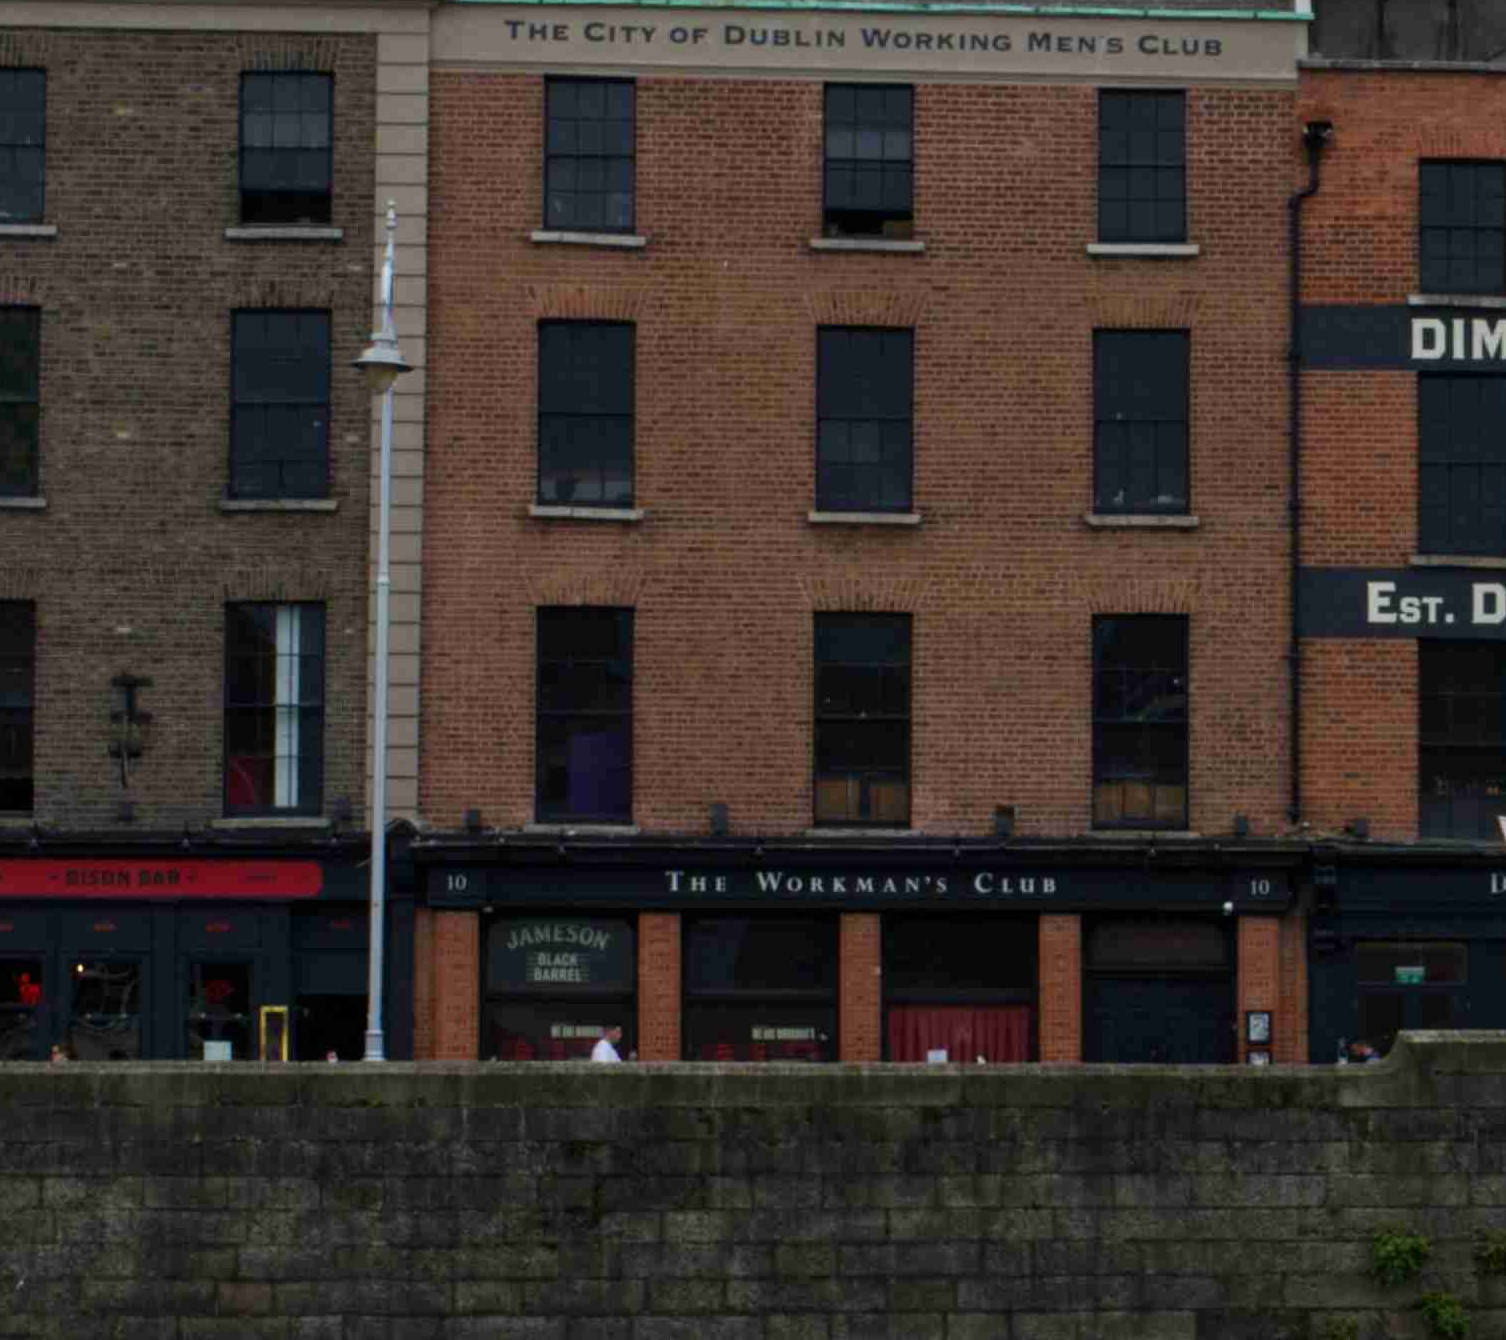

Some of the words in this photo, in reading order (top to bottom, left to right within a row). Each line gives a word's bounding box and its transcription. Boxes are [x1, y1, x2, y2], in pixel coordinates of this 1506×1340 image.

[504, 18, 570, 41] THE
[583, 20, 657, 46] CITY
[669, 25, 709, 44] OF
[724, 24, 846, 48] DUBLIN
[861, 27, 1012, 54] WORKING
[1137, 33, 1224, 57] CLUB
[64, 868, 131, 888] BISON
[138, 868, 181, 888] BAR
[446, 873, 468, 892] 10
[664, 870, 728, 893] THE
[757, 870, 950, 893] WORKMAN'S
[973, 871, 1059, 895] CLUB
[1250, 878, 1271, 896] 10
[506, 923, 611, 951] JAMESON
[536, 952, 579, 967] BLACK
[533, 968, 582, 983] BARREL
